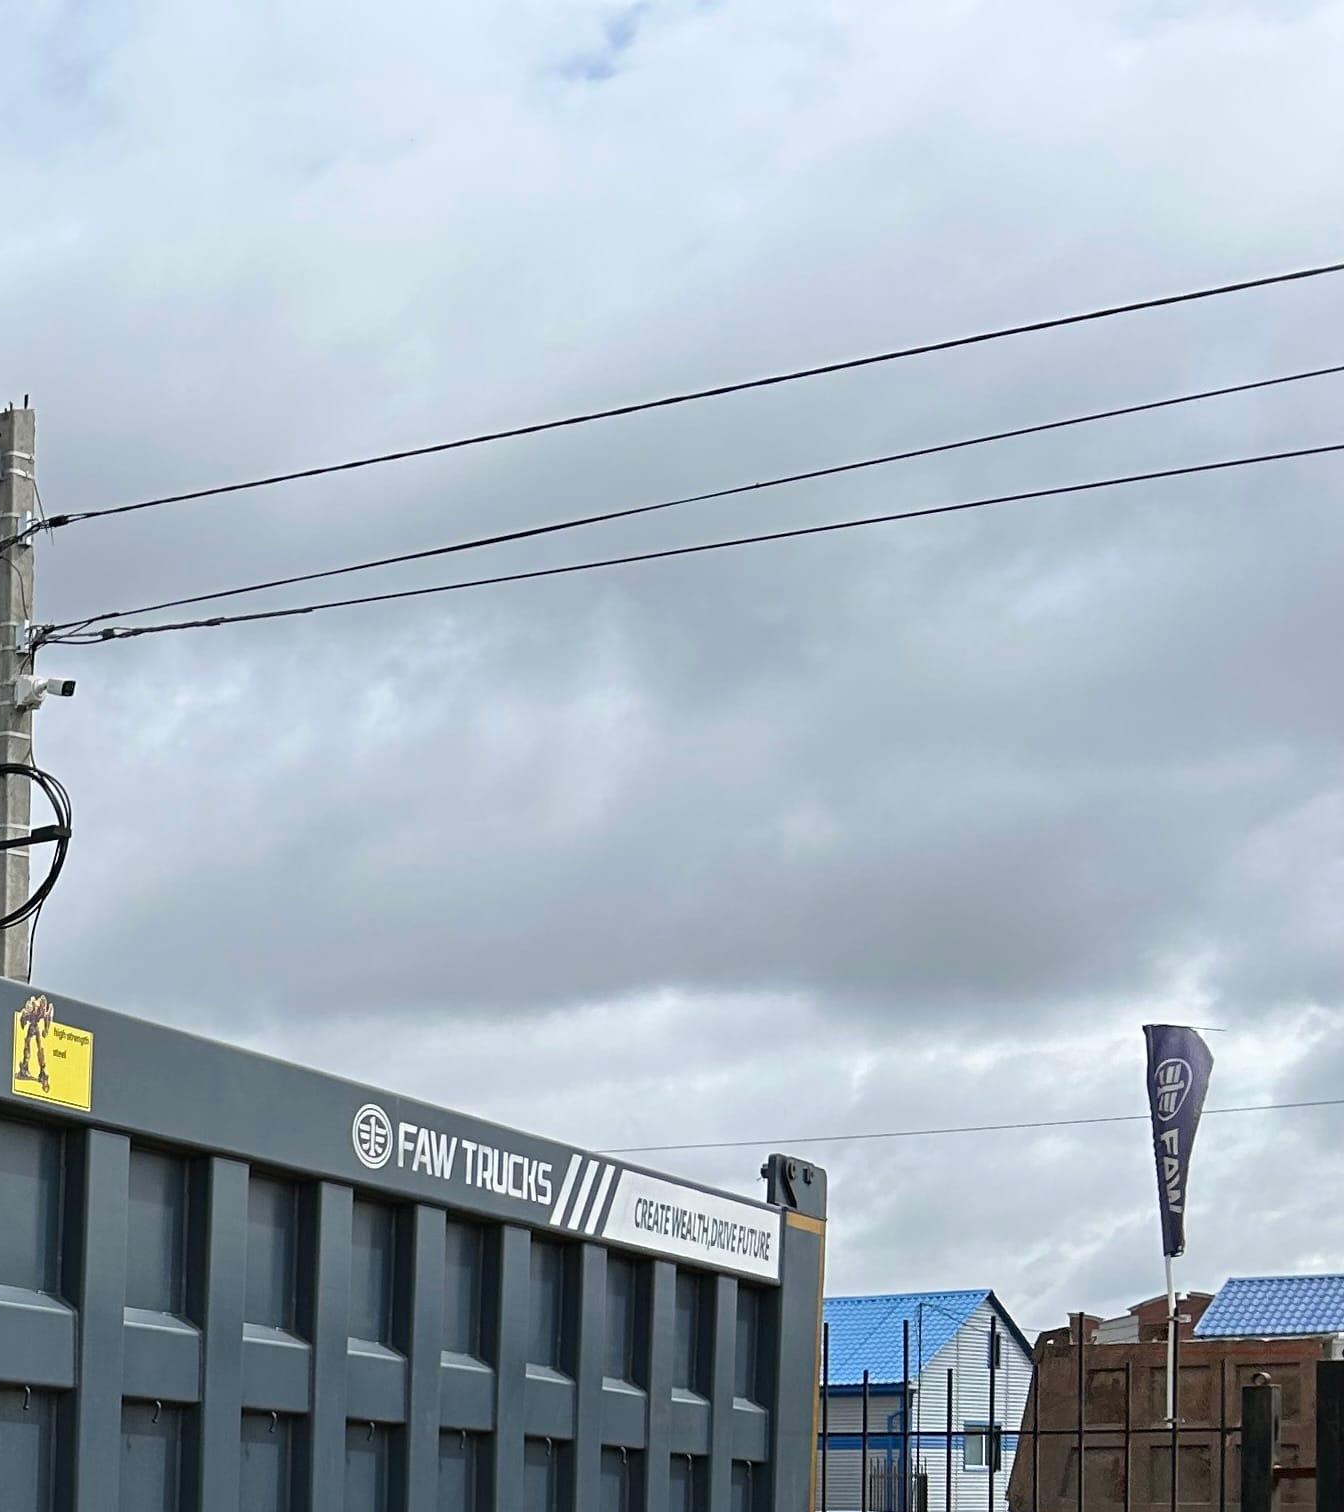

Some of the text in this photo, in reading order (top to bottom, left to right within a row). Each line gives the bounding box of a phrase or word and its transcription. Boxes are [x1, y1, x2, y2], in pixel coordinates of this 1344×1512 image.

[397, 1121, 553, 1206] FAW TRUCKS
[1160, 1127, 1183, 1215] FAW
[634, 1197, 671, 1236] CREATE
[736, 1225, 772, 1262] FUTURE
